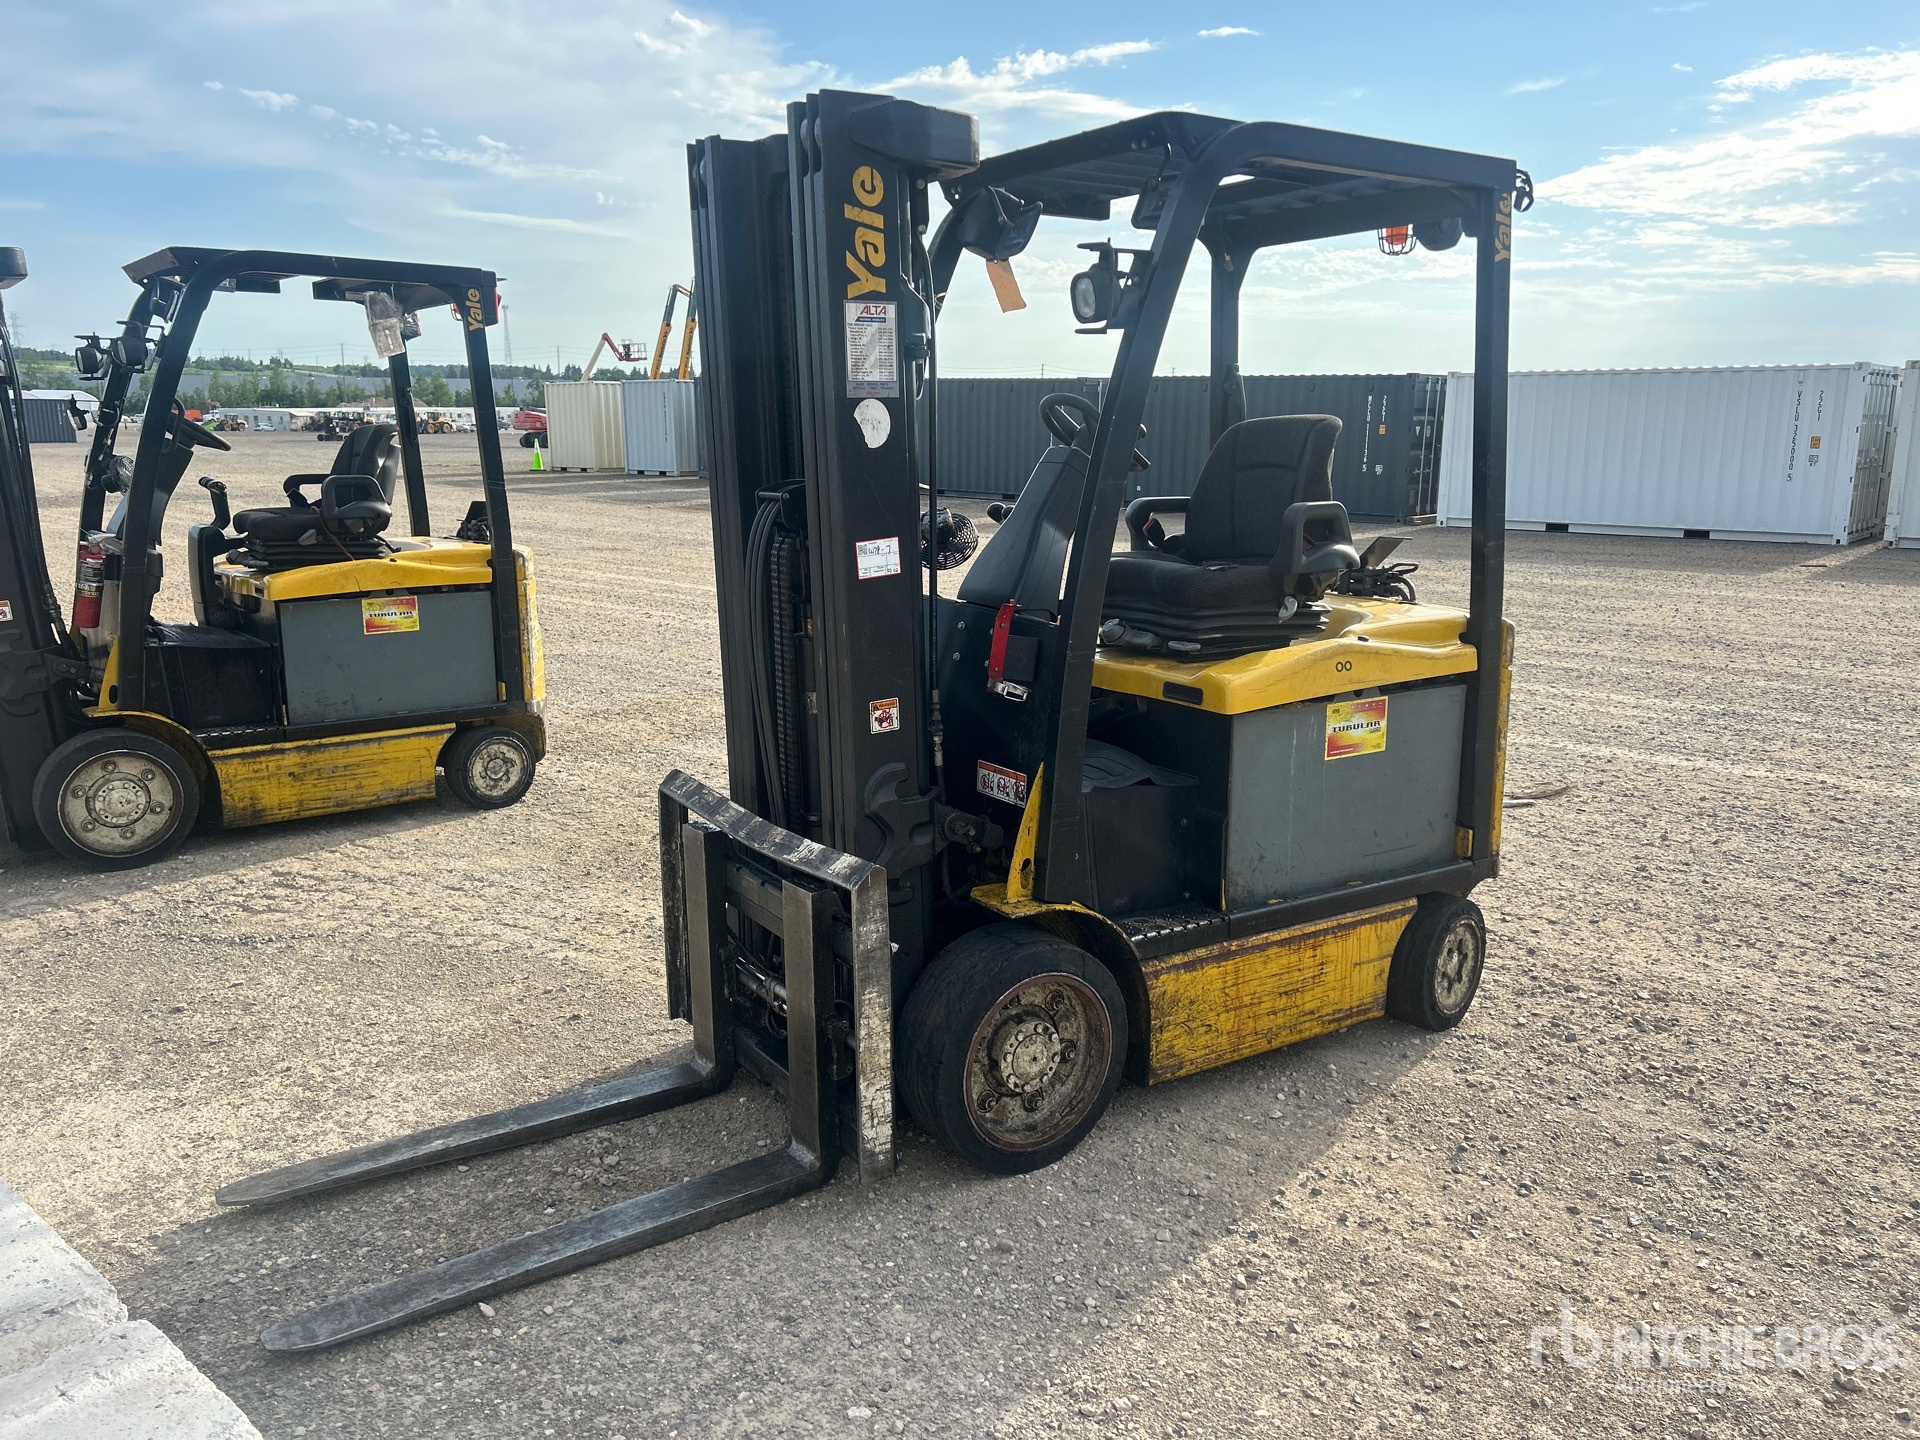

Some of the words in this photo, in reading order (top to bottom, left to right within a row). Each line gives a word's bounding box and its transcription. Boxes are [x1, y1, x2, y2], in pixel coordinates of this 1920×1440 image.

[843, 164, 887, 300] Yale
[1494, 192, 1511, 263] Yale
[465, 288, 484, 331] Yale
[860, 304, 887, 316] ALTA
[1794, 390, 1803, 421] VSLU
[1789, 424, 1798, 471] 325000
[1362, 464, 1367, 472] 5
[1787, 473, 1792, 482] 5
[1332, 720, 1381, 733] TUBULAR
